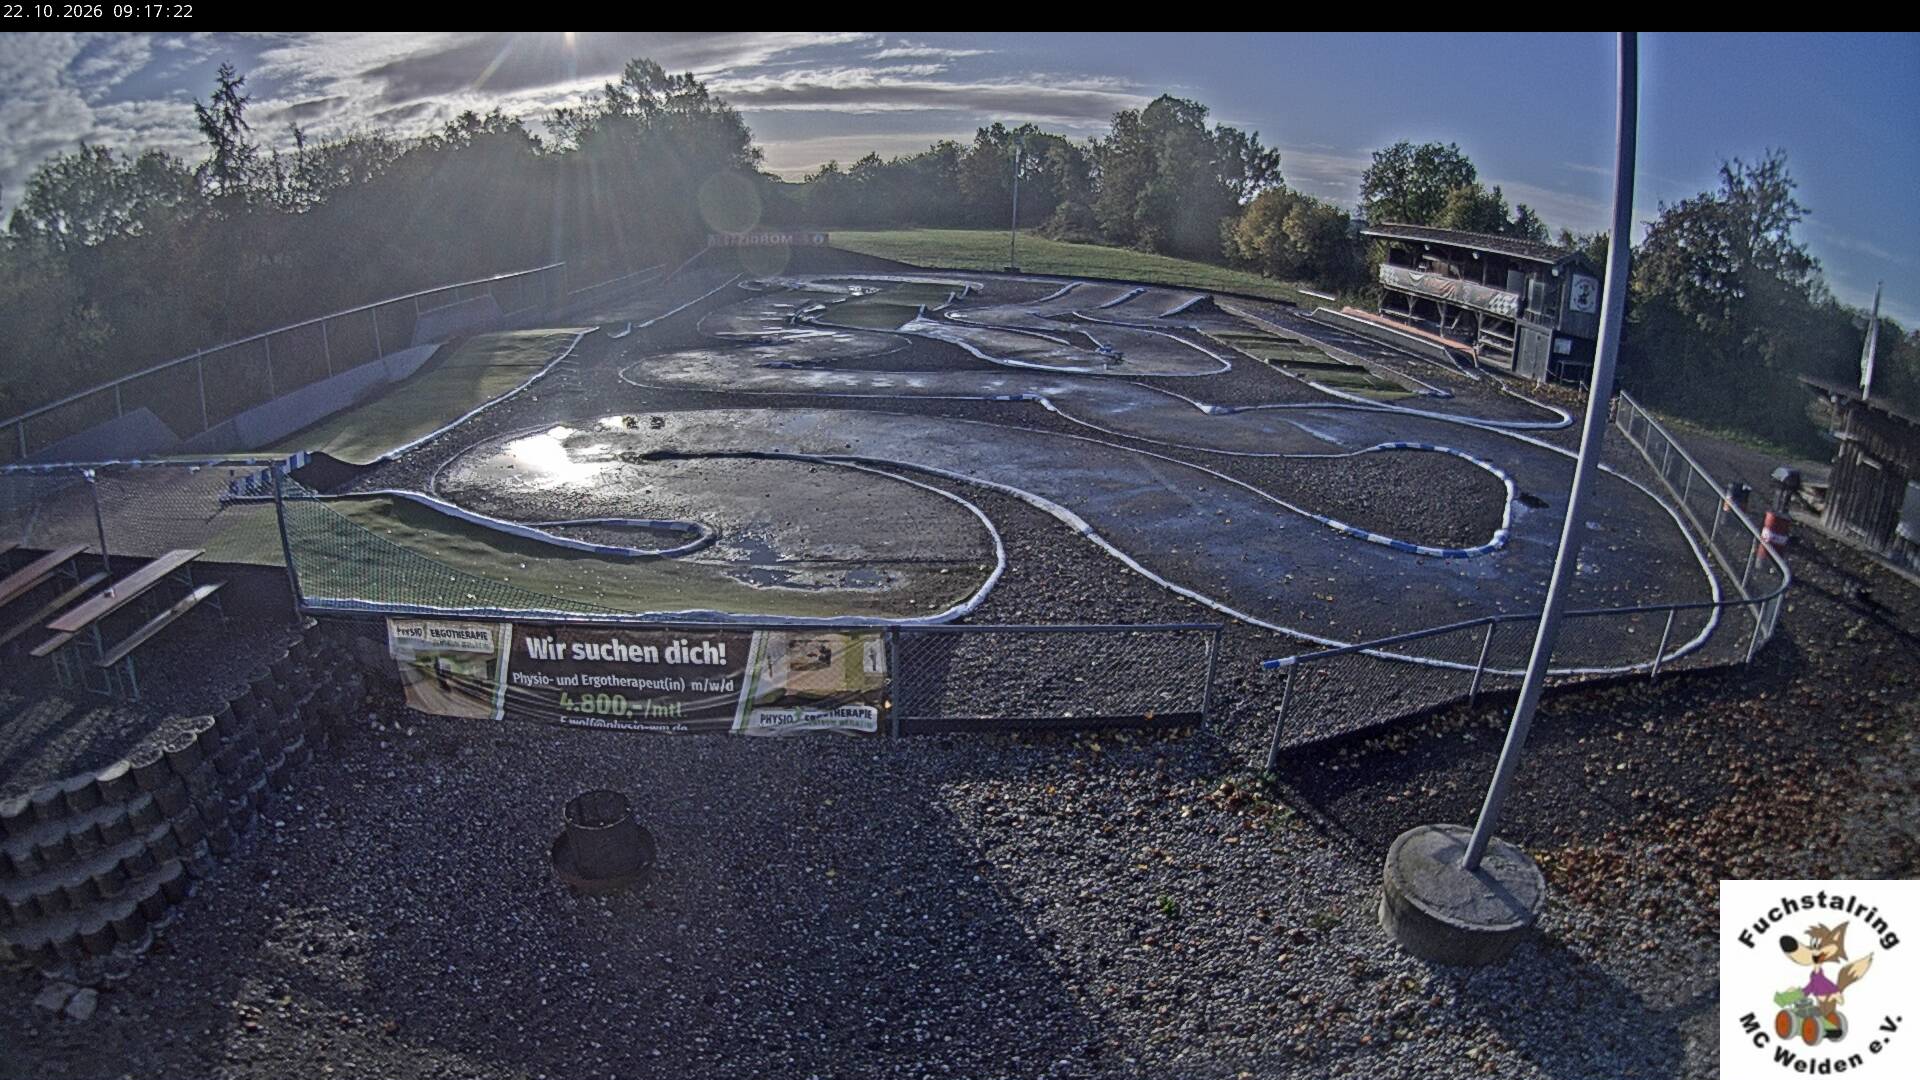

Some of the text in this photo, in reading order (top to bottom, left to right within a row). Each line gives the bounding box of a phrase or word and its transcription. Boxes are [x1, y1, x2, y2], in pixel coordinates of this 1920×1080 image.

[430, 629, 488, 641] ERGOTHERAPIE
[525, 636, 727, 665] Wir suchen dich!
[512, 672, 734, 693] Physio- und Ergotherapeut(in) m/w/d
[760, 713, 794, 725] PHYSIO
